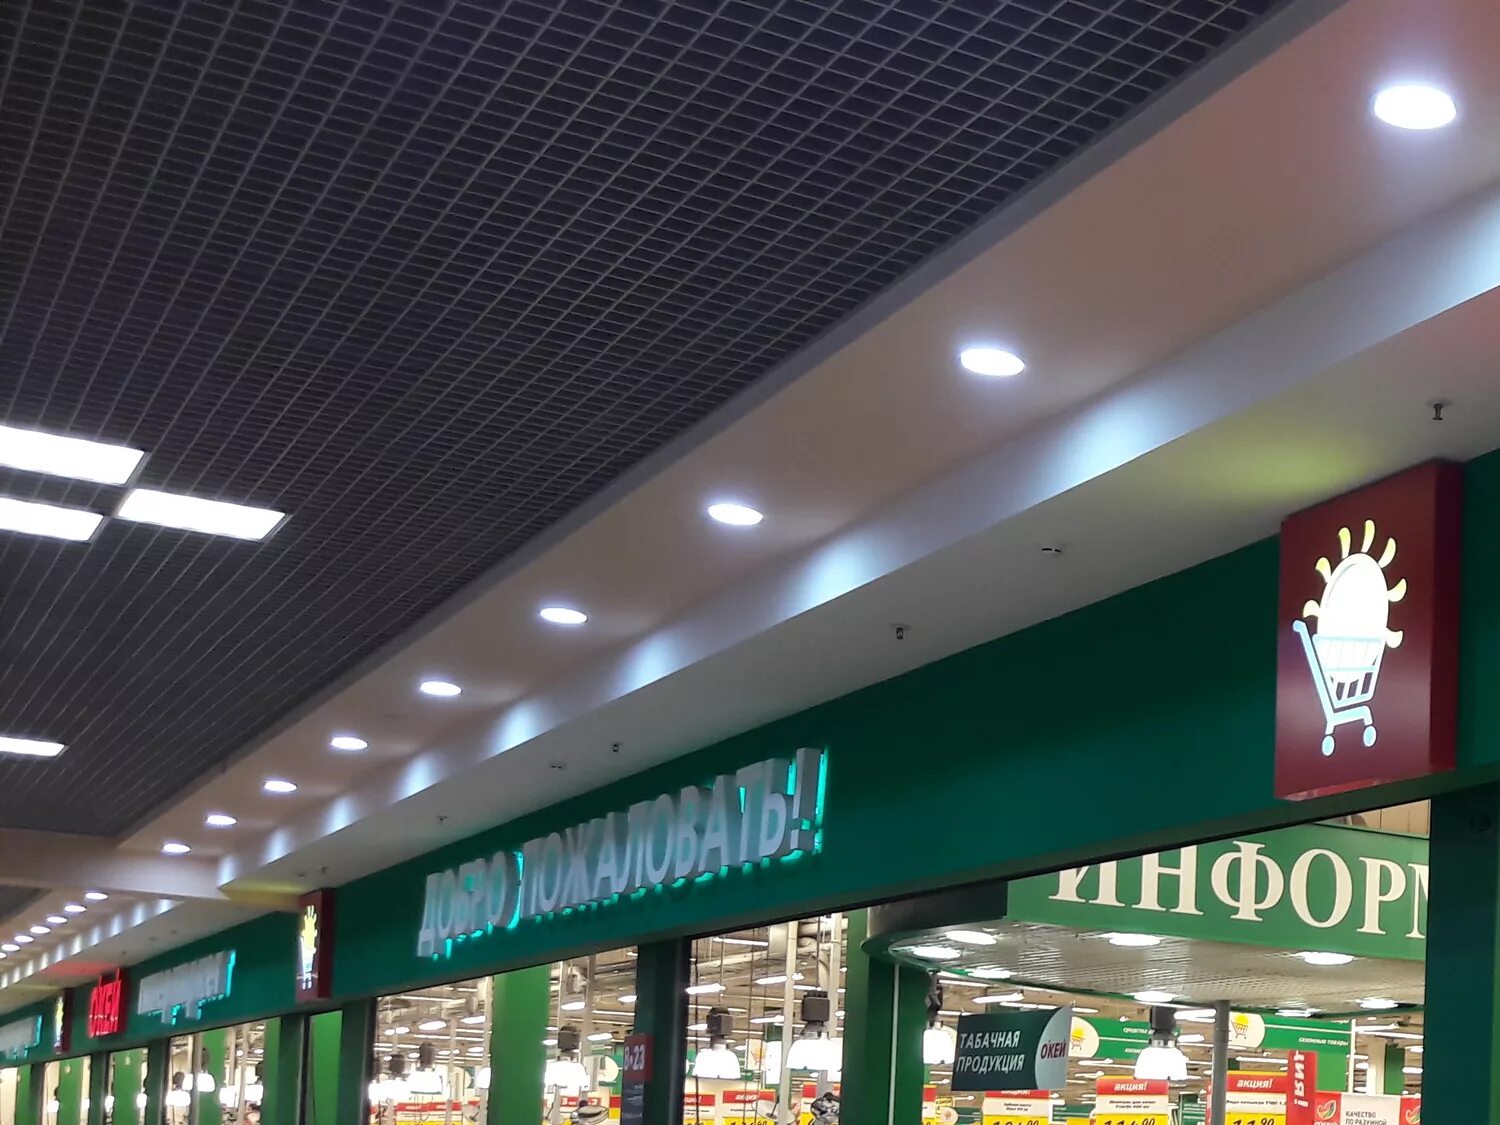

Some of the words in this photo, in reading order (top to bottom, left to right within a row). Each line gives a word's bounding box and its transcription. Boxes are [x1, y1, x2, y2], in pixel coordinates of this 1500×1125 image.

[417, 848, 524, 960] ДОБРО
[518, 746, 829, 918] ПОЖАЛОВАТЬ!
[959, 1030, 1021, 1050] ТАБАЧНАЯ
[956, 1053, 1025, 1075] ПРОДУКЦИЯ
[1114, 1082, 1148, 1092] акция!
[1237, 1078, 1273, 1089] акция!
[1346, 1111, 1377, 1119] КАЧЕСТВО
